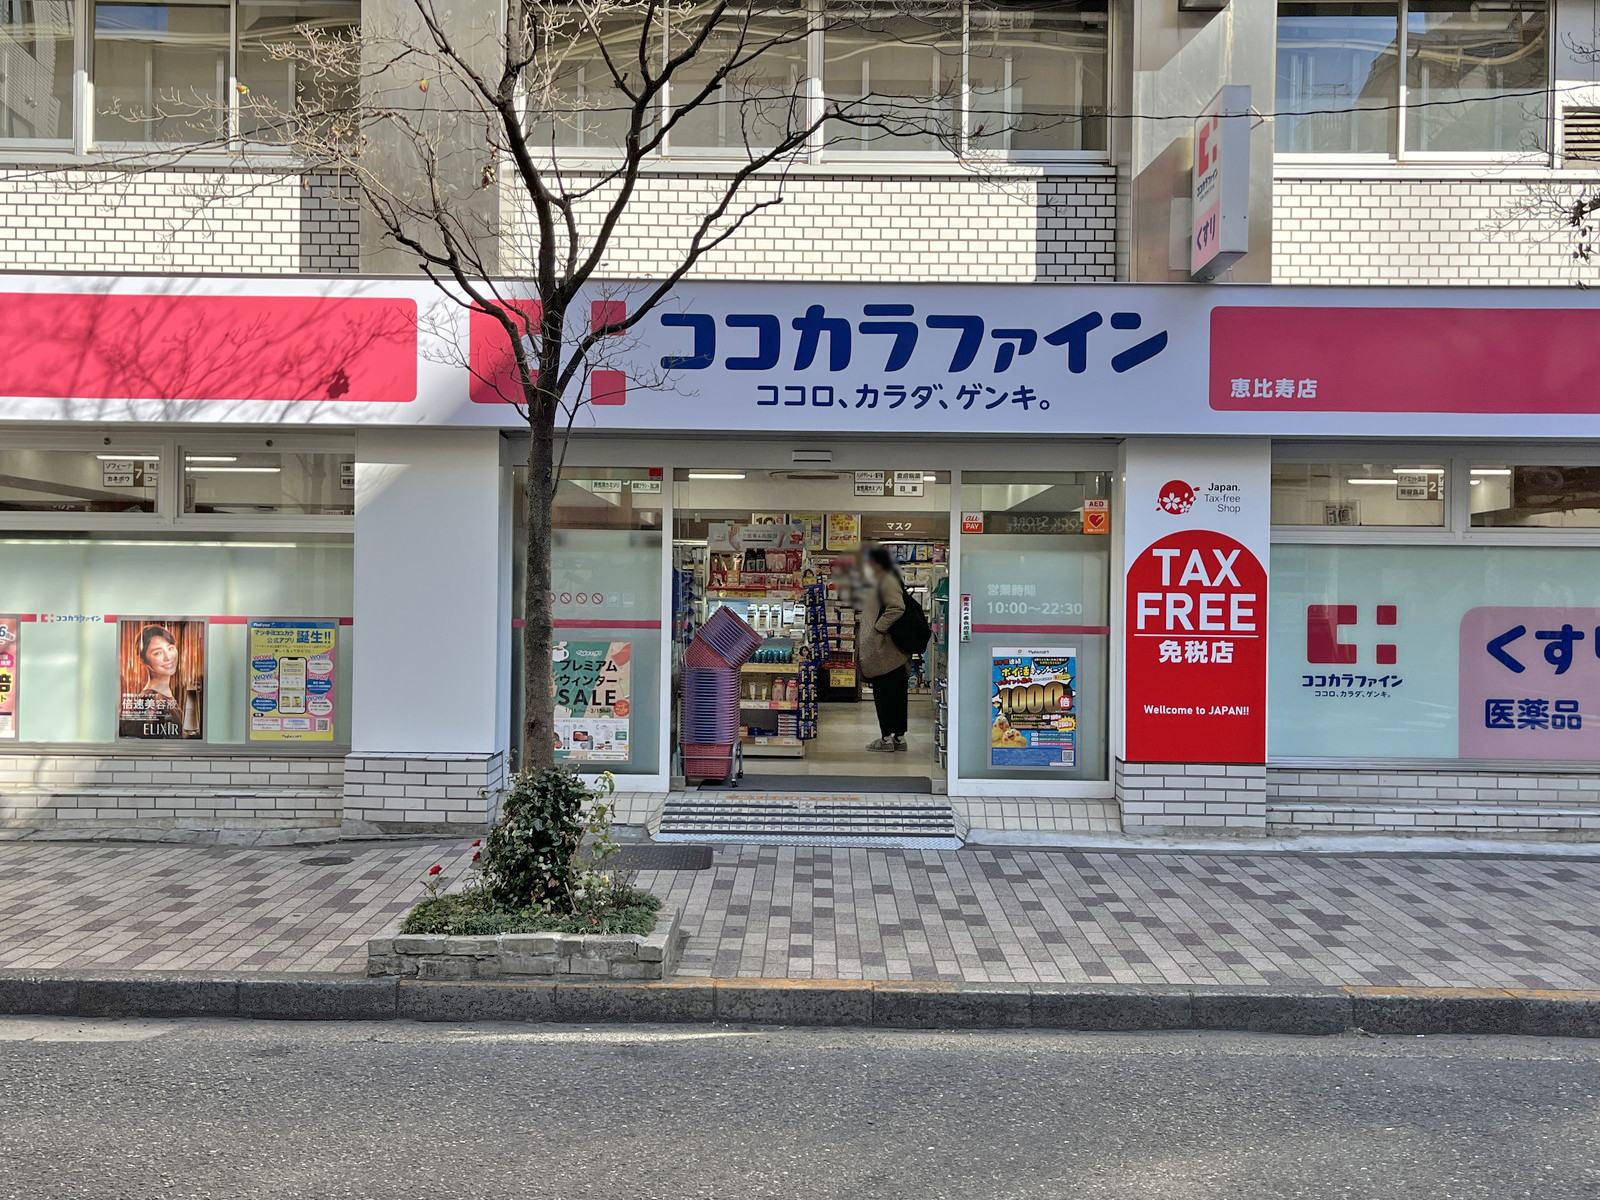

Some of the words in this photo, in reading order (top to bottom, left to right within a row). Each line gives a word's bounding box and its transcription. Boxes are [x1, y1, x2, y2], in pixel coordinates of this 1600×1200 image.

[1196, 213, 1216, 251] くすり
[660, 303, 1169, 375] ココカラファイン
[1230, 378, 1319, 399] 恵比寿店
[756, 383, 1052, 411] ココロ、カラダ、ゲンキ。
[134, 468, 143, 479] 7
[885, 478, 893, 489] 4
[1208, 483, 1241, 492] Japan.
[1429, 481, 1437, 492] 2
[1204, 493, 1241, 502] Tax-free
[1217, 504, 1241, 514] Shop
[886, 522, 912, 530] マスク
[1152, 548, 1242, 588] TAX
[987, 583, 1037, 596] 営業時間
[1136, 591, 1257, 632] FREE
[1158, 640, 1235, 664] 免税店
[559, 660, 618, 671] プレミアム
[559, 674, 618, 687] ウィンター
[1301, 673, 1404, 688] ココカラファイン
[122, 698, 178, 710] 倍速美容液
[558, 689, 617, 706] SALE
[1143, 704, 1193, 715] Wellcome
[1195, 706, 1206, 715] to
[1208, 705, 1250, 716] JAPAN!!
[1484, 698, 1583, 731] 医薬品
[143, 722, 179, 736] ELIXIR
